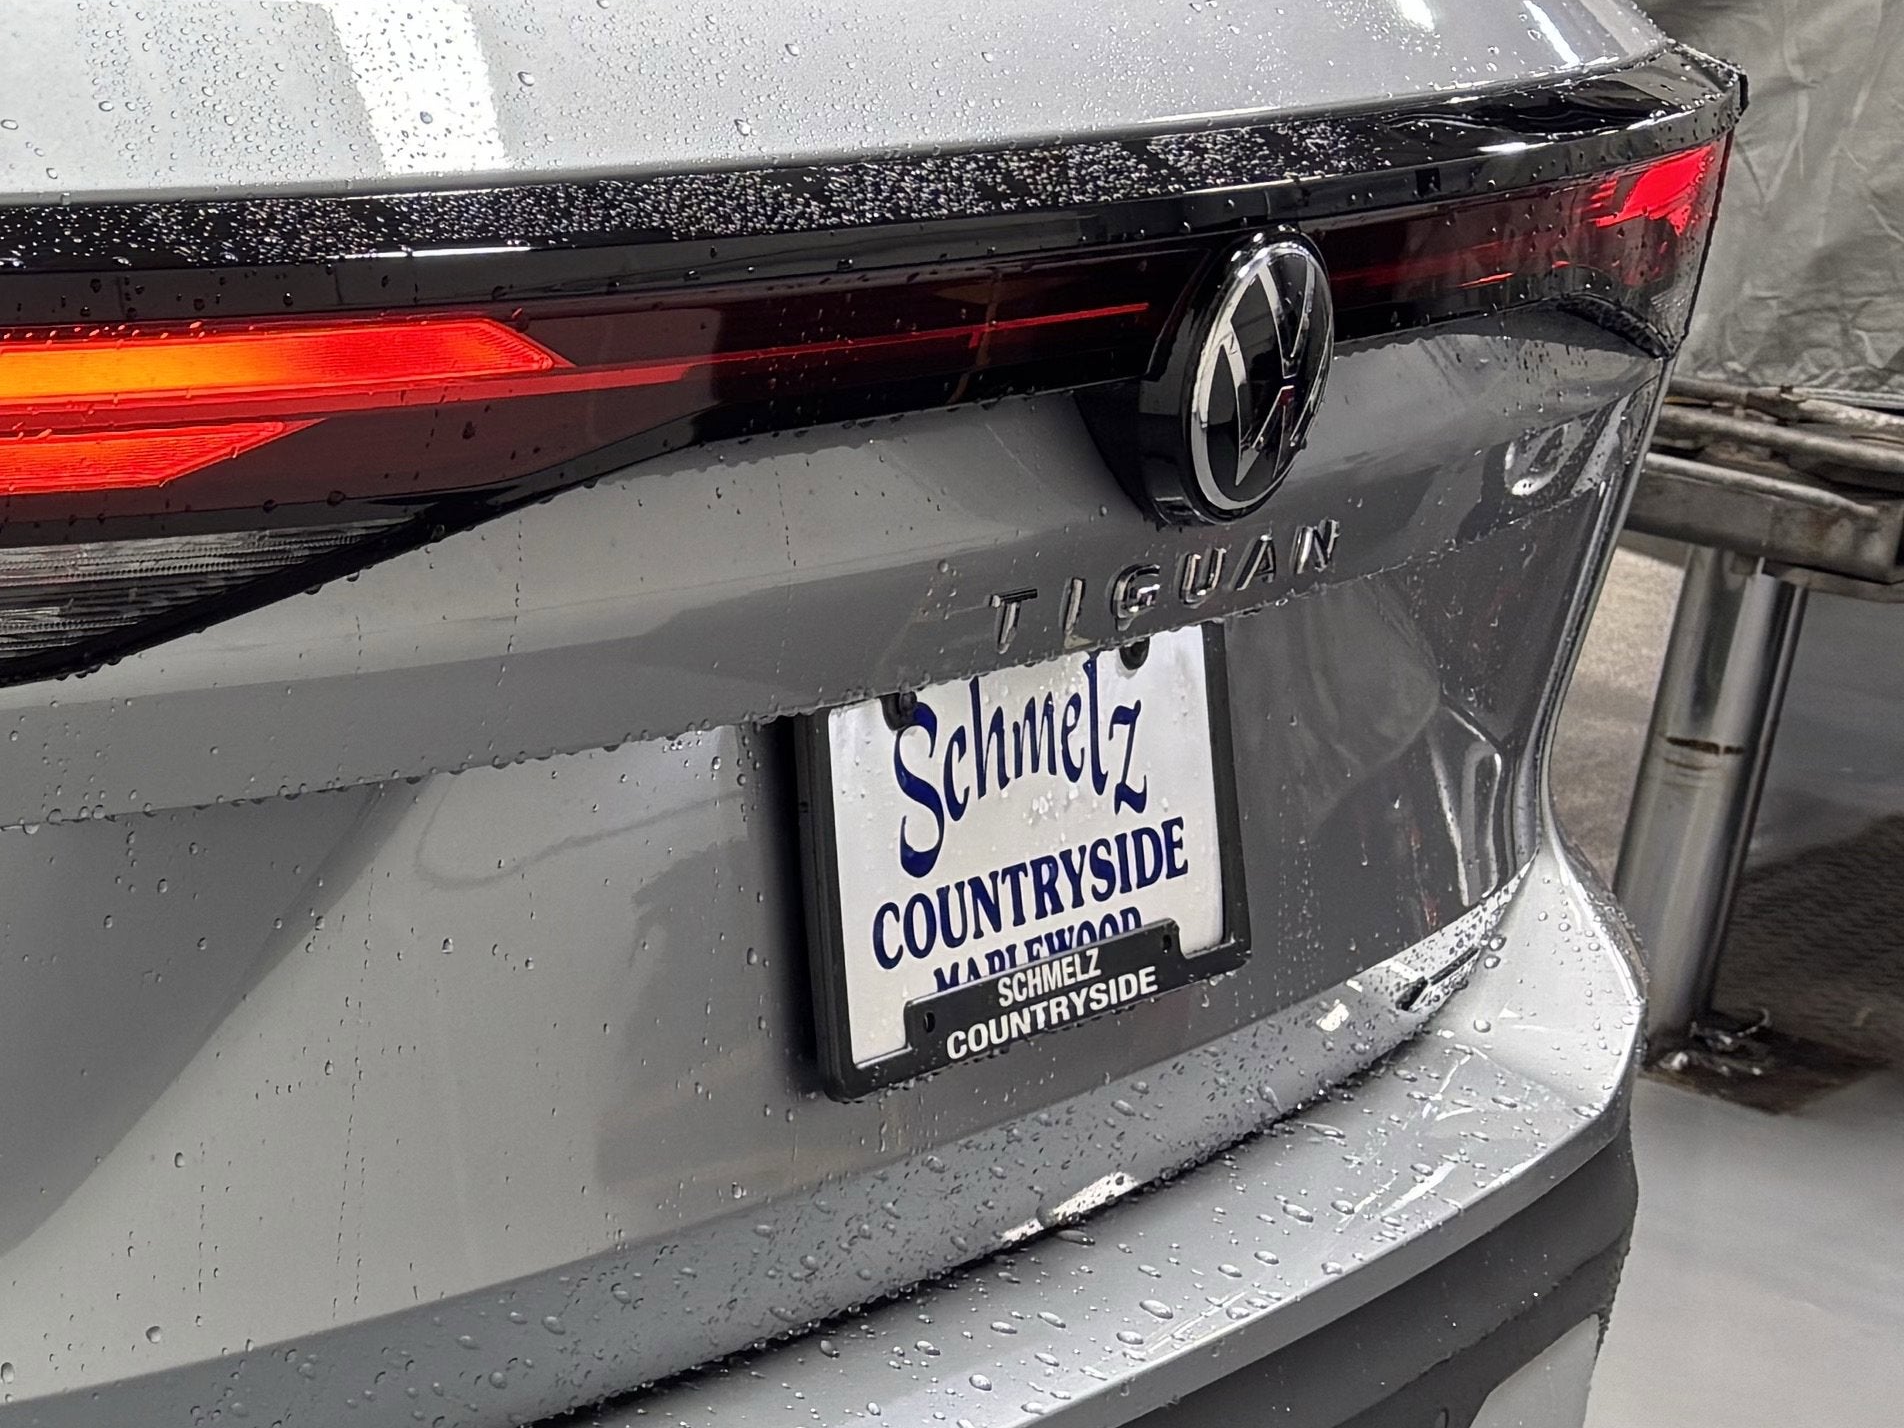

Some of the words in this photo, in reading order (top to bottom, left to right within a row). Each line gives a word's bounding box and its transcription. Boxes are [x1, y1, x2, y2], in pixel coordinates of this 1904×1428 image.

[989, 519, 1341, 655] TIGUAN
[893, 651, 1148, 879] Schmelz
[873, 816, 1189, 970] COUNTRYSIDE
[946, 966, 1159, 1060] COUNTRYSIDE
[998, 948, 1102, 1007] SCHMELZ
